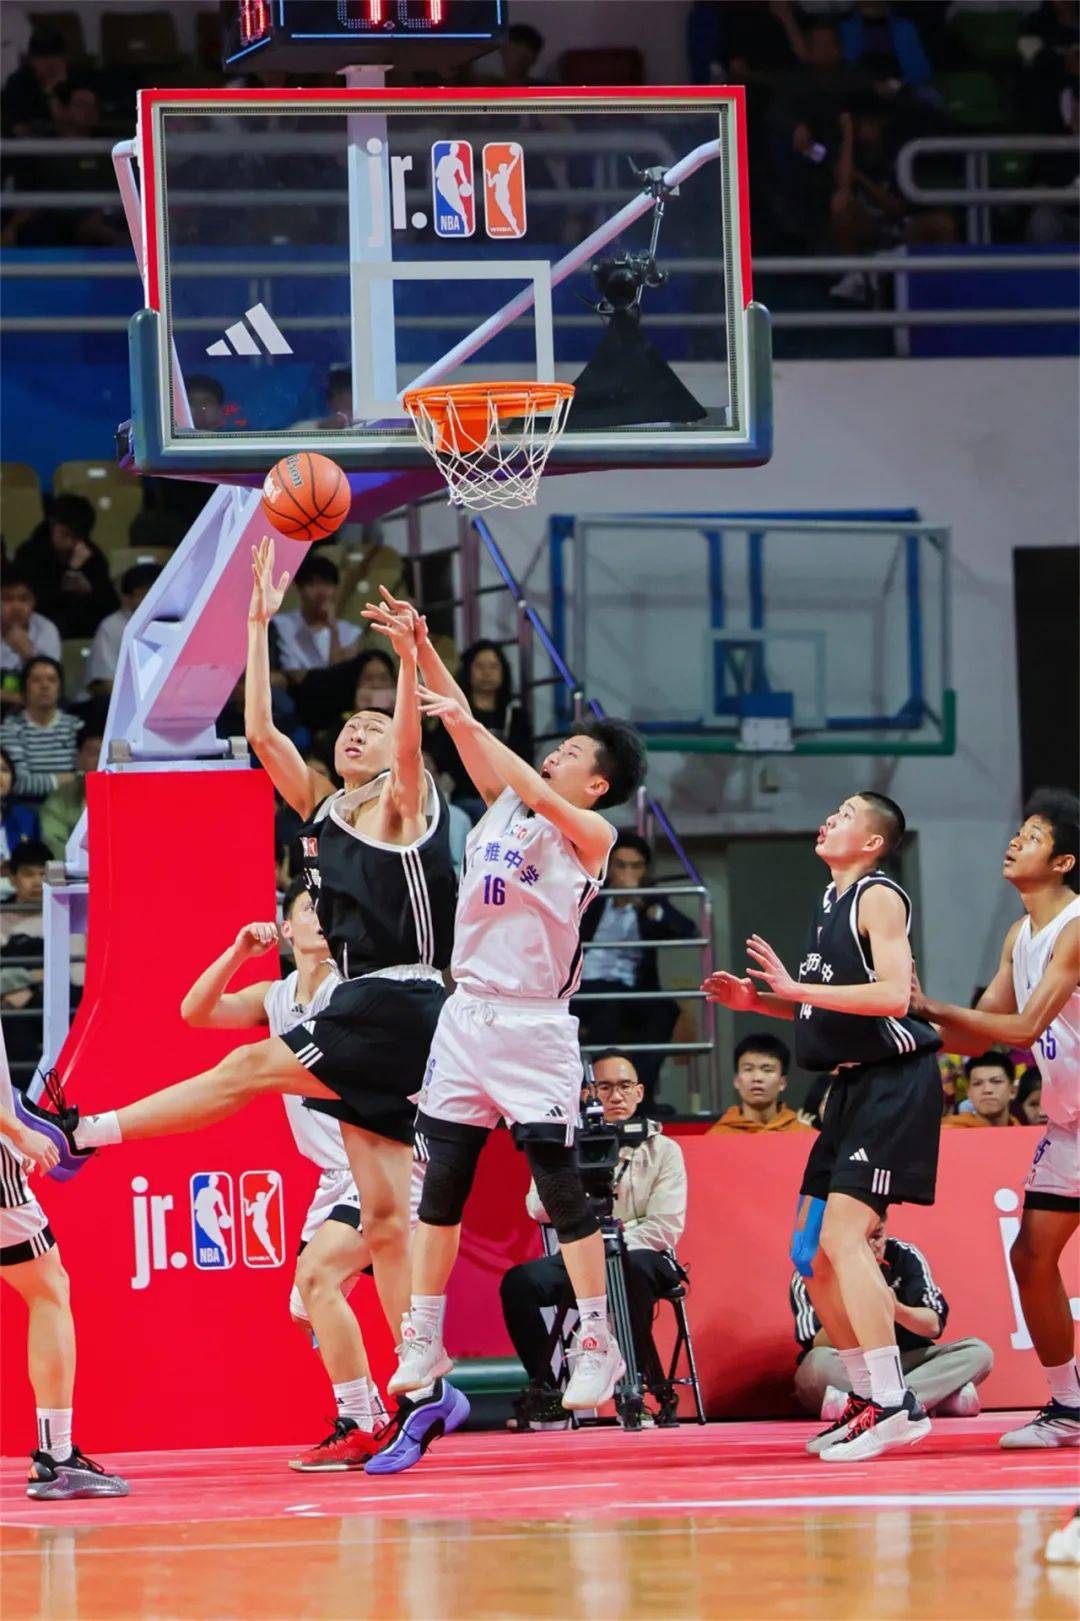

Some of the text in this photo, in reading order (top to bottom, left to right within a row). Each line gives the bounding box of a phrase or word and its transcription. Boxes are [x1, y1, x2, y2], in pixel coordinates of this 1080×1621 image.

[366, 138, 428, 247] jr.
[440, 215, 461, 231] NBA
[484, 874, 506, 906] 16
[1036, 1025, 1056, 1060] 15
[131, 1176, 187, 1289] jr.
[200, 1247, 221, 1263] NBA
